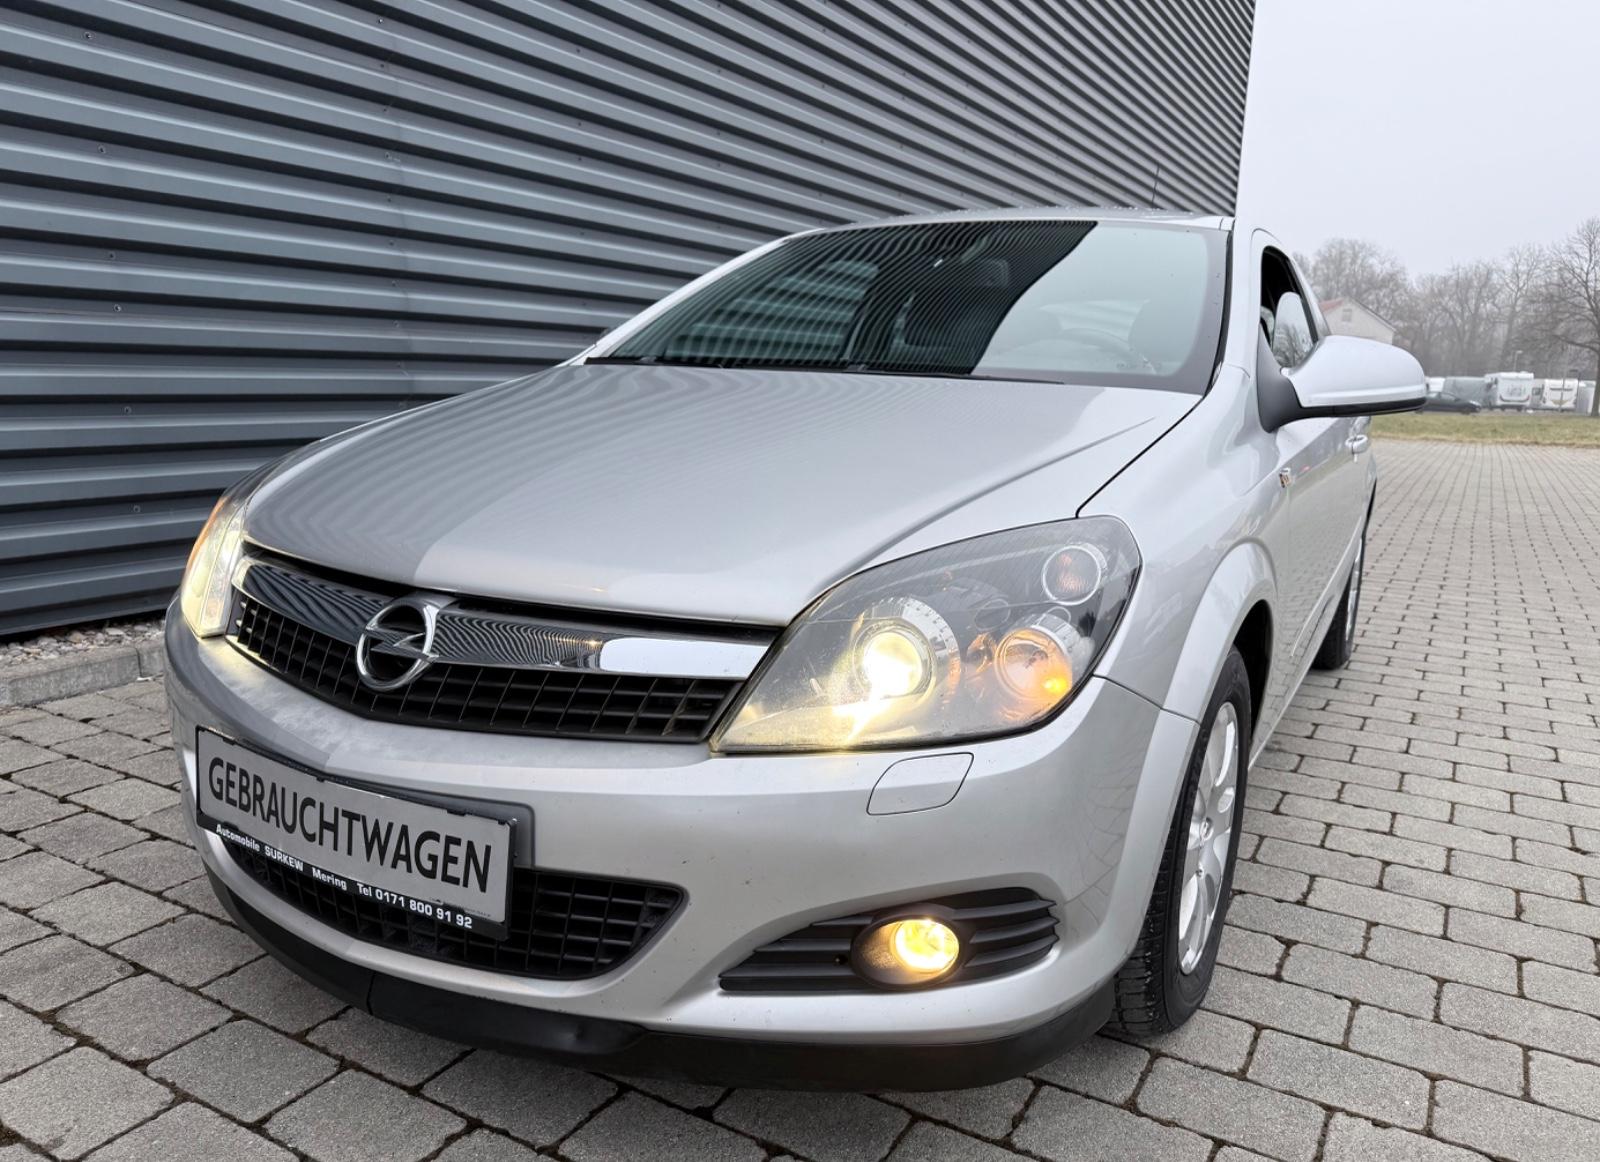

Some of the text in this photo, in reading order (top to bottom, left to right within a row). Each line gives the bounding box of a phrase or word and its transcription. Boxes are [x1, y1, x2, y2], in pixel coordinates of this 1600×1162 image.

[208, 757, 492, 893] GEBRAUCHTWAGEN
[216, 824, 260, 852] Automobile
[264, 845, 304, 871] SURKEW
[312, 867, 348, 891] Mering
[357, 883, 372, 897] Tel
[375, 889, 405, 908] 0171
[409, 899, 432, 916] 800
[436, 908, 451, 922] 91
[456, 914, 473, 929] 92
